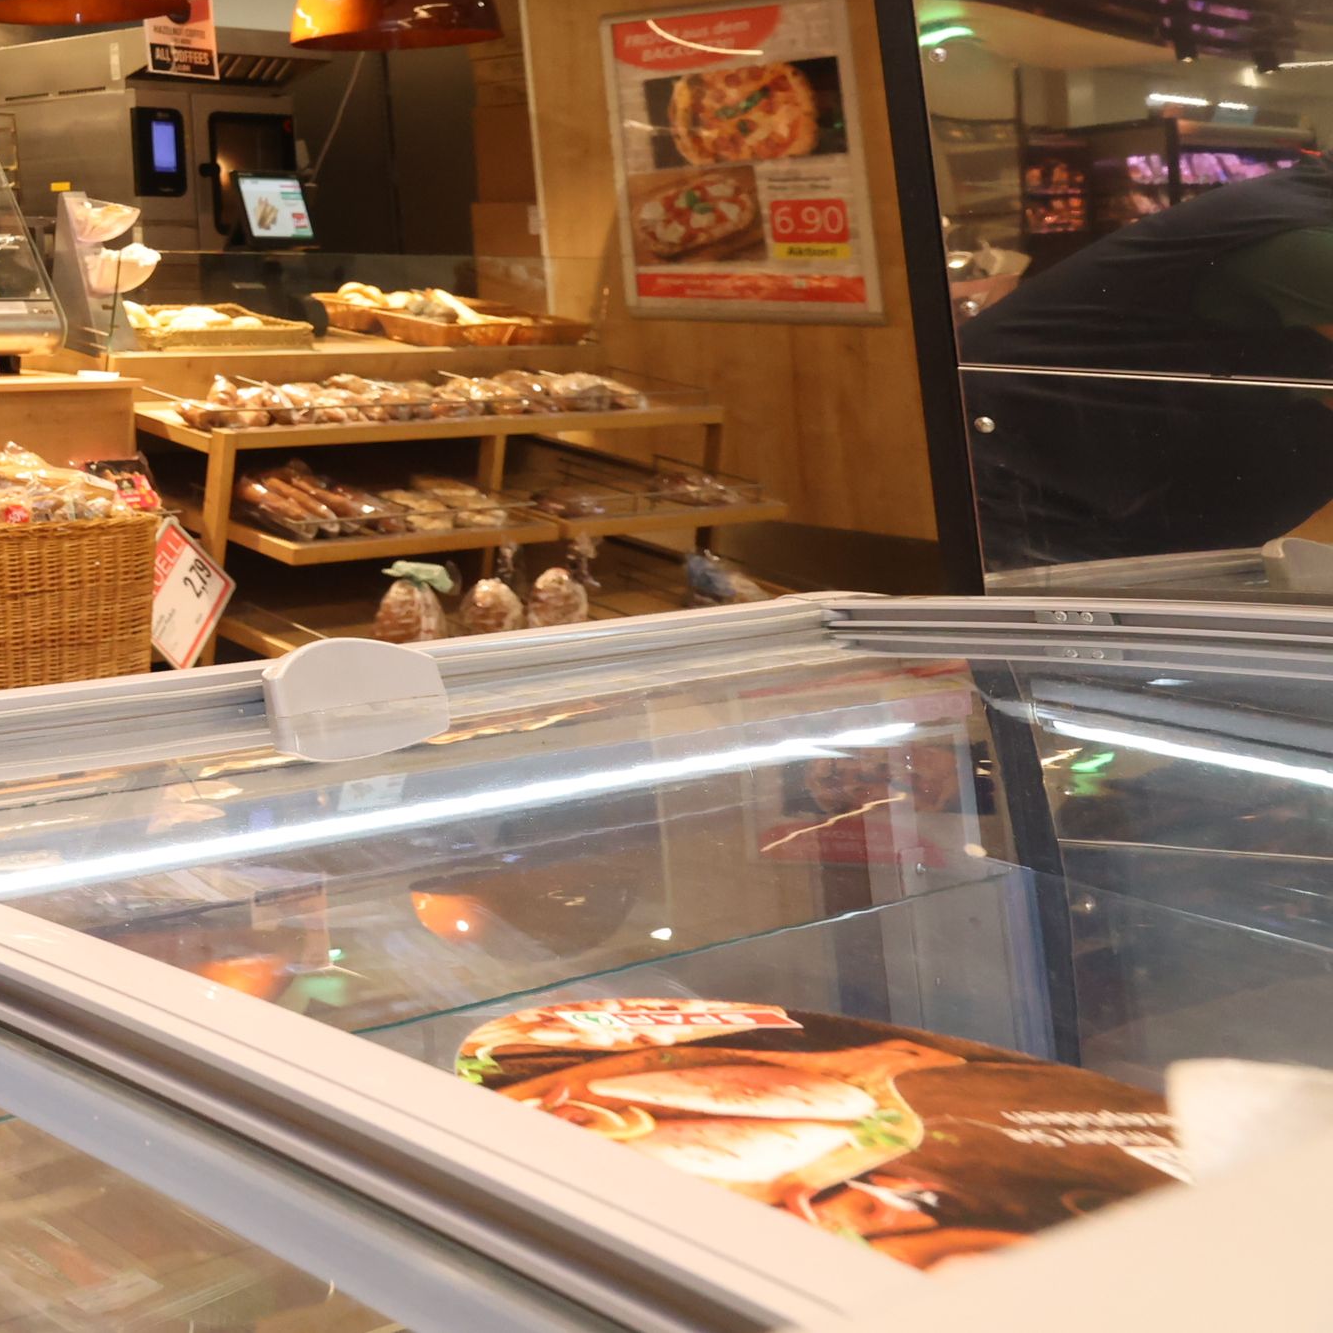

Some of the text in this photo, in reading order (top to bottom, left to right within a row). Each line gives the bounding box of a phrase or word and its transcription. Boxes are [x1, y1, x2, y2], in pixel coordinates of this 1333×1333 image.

[773, 204, 845, 235] 6.90
[153, 531, 186, 597] UELL!
[183, 557, 213, 599] 2,79
[617, 1014, 757, 1027] SPAR
